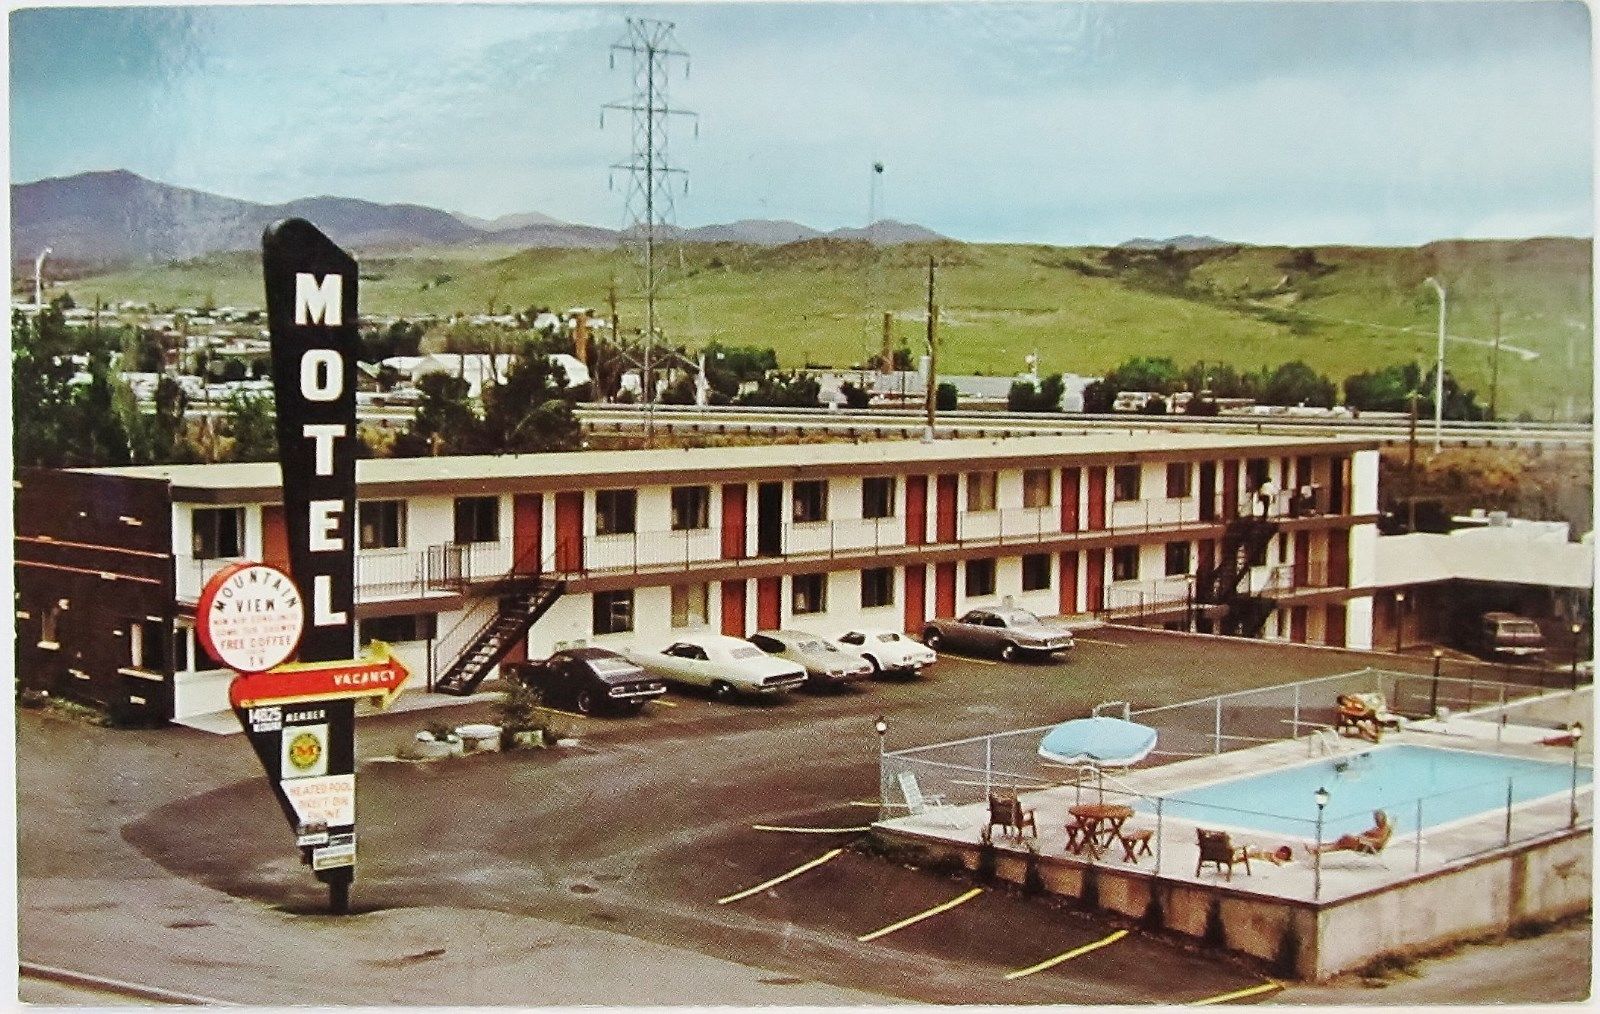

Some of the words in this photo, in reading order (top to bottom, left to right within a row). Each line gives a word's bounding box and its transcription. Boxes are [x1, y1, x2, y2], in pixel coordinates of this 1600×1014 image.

[295, 272, 348, 627] MOTEL
[214, 570, 297, 612] MOUNTAIN
[236, 599, 275, 612] VIEW
[333, 669, 396, 686] VACANCY
